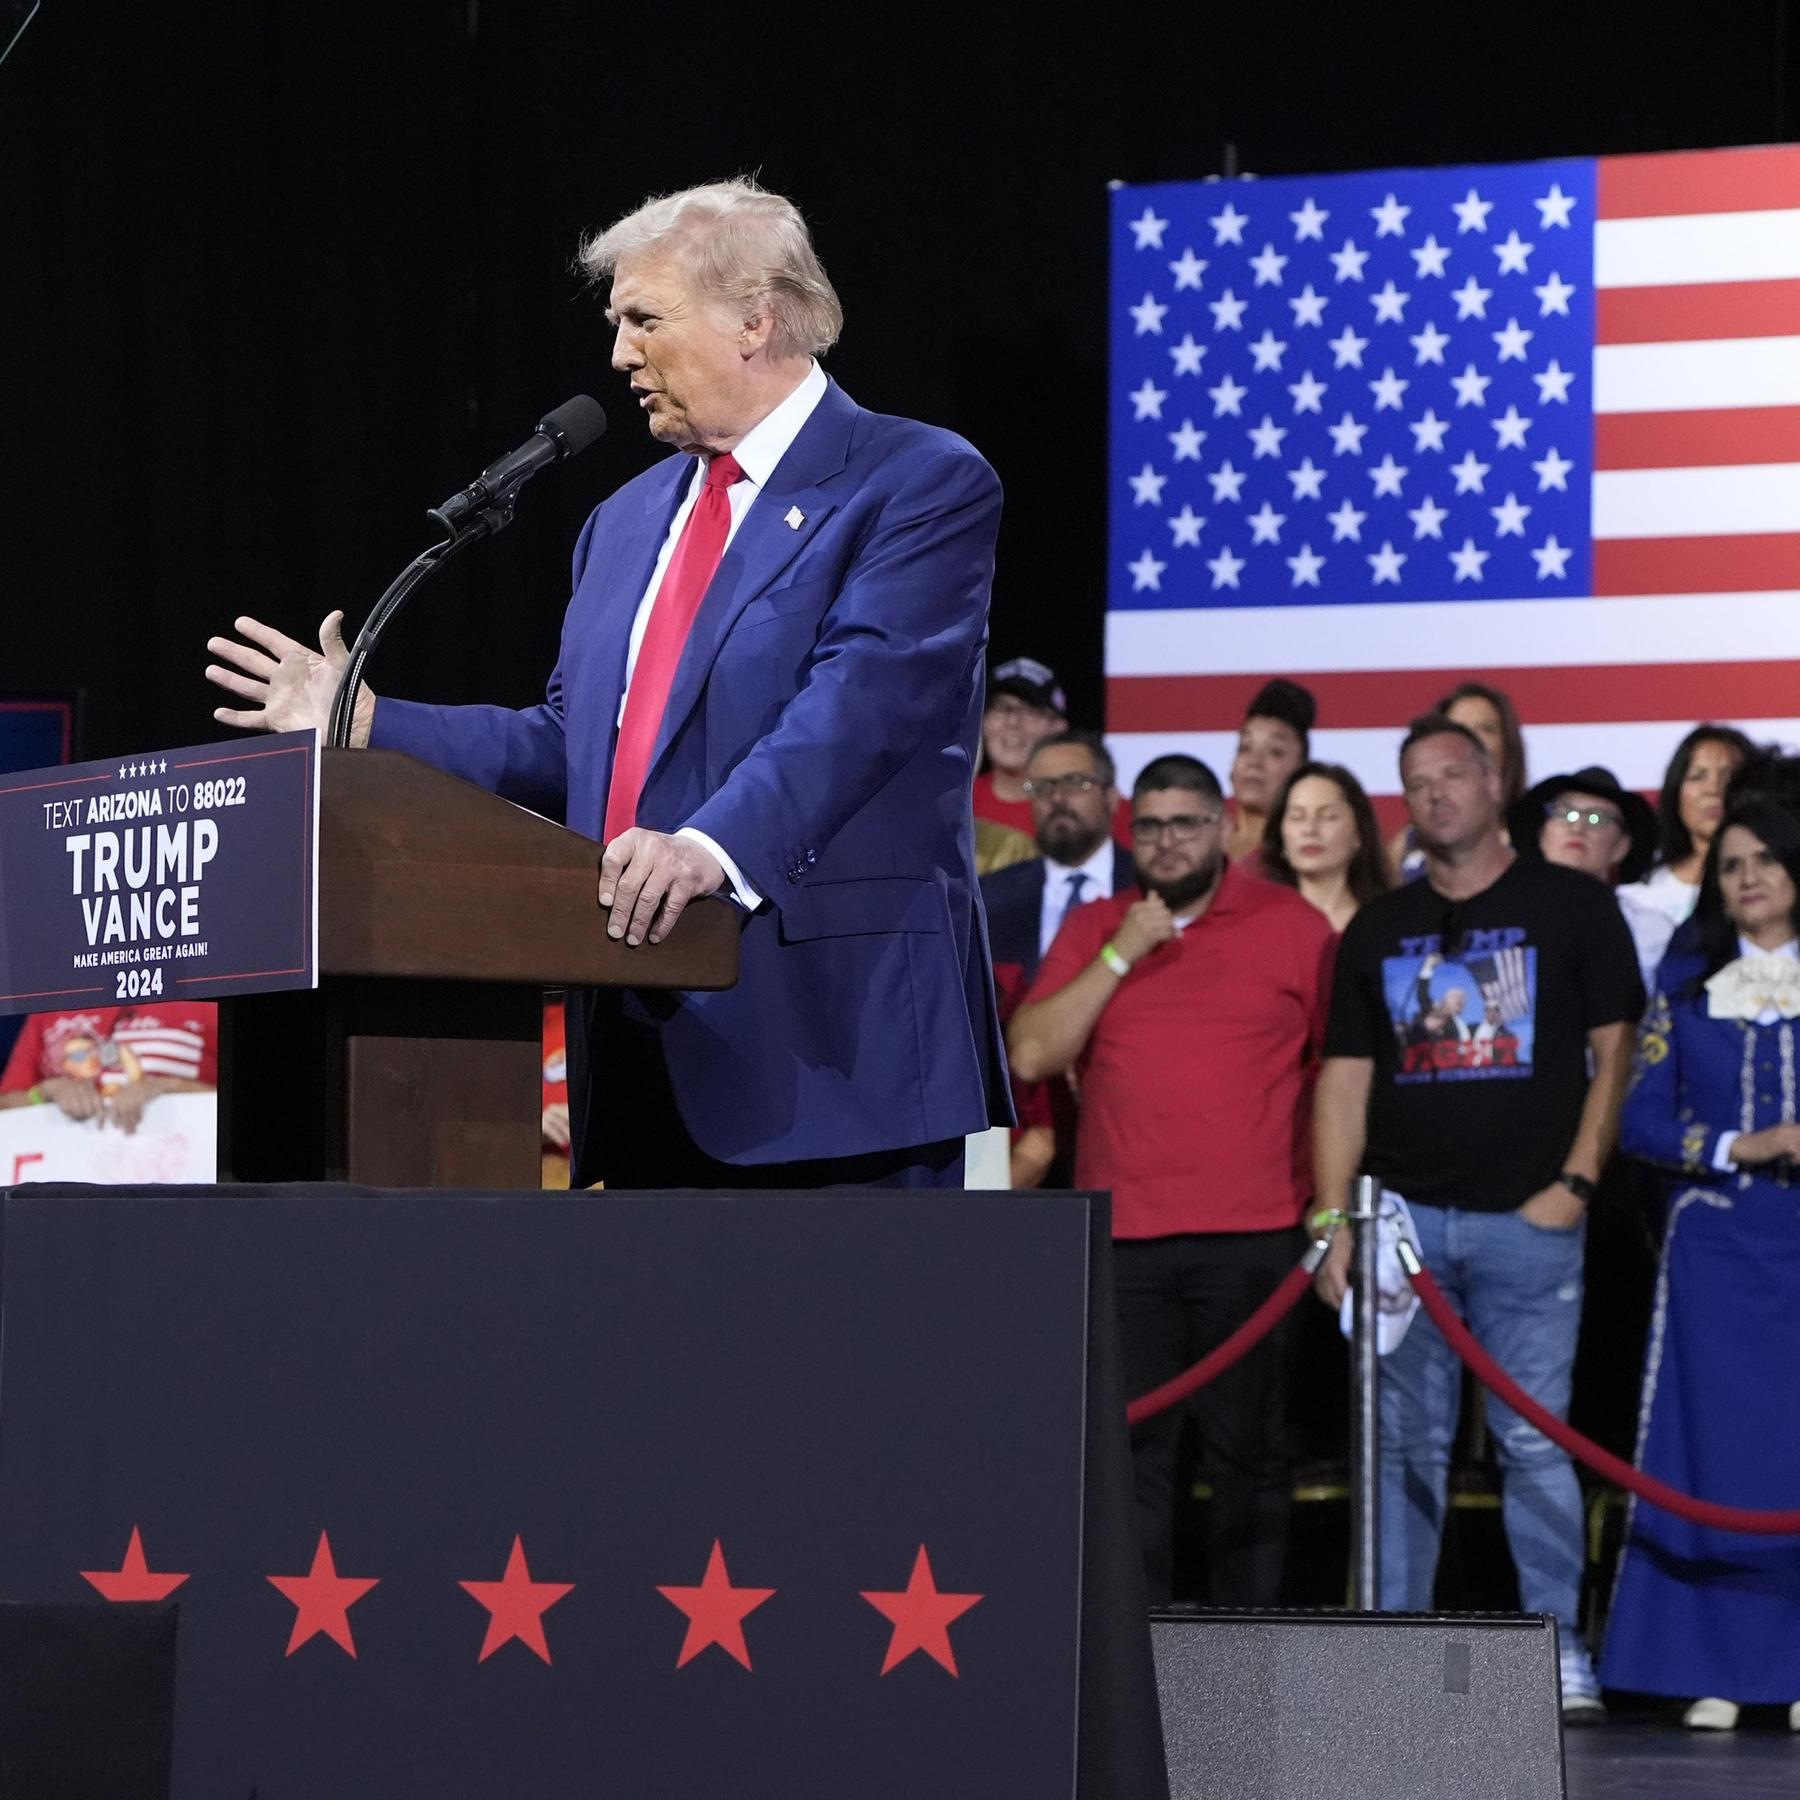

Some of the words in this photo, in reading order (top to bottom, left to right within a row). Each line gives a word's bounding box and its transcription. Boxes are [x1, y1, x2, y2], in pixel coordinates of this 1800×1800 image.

[43, 798, 84, 830] TEXT
[86, 788, 163, 825] ARIZONA
[166, 784, 189, 814] TO
[193, 776, 246, 811] 88022
[66, 818, 219, 895] TRUMP
[81, 885, 200, 946] VANCE
[73, 952, 99, 969] MAKE
[100, 949, 141, 966] AMERICA
[143, 945, 173, 962] GREAT
[175, 942, 208, 959] AGAIN!
[116, 967, 163, 999] 2024
